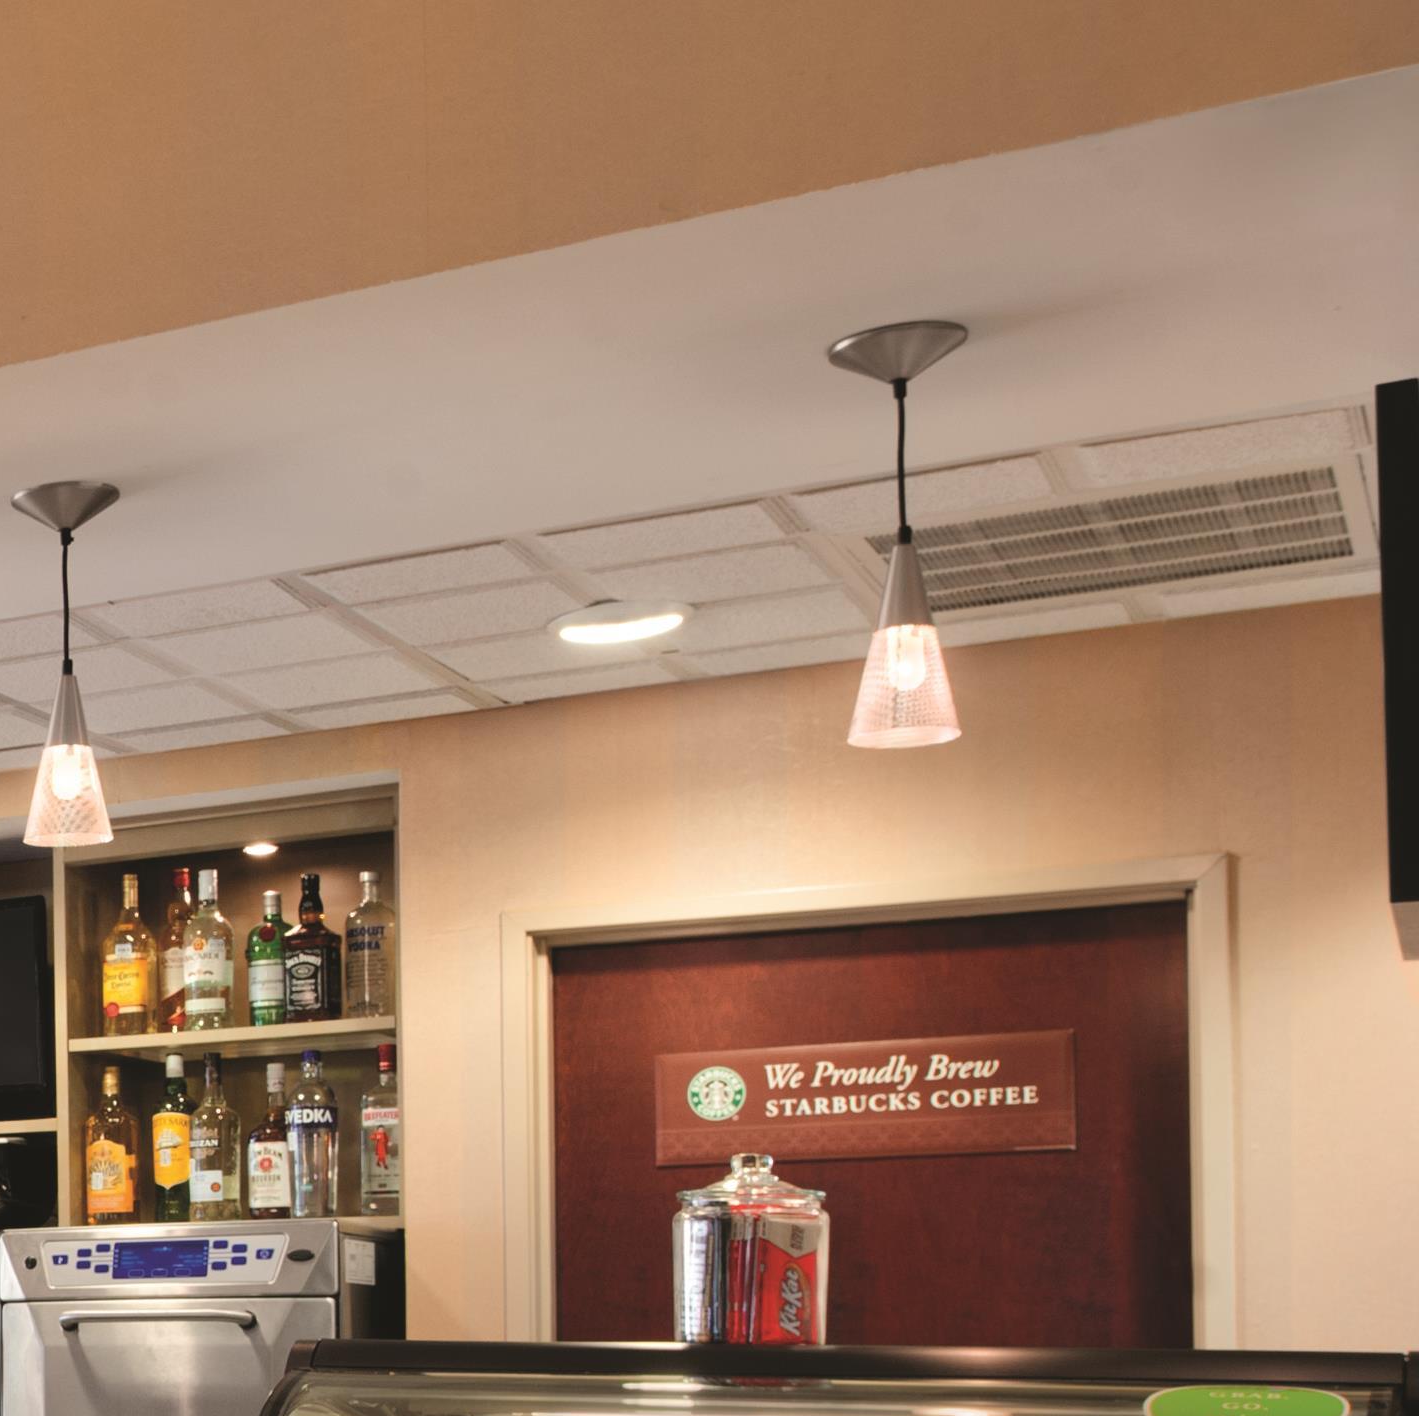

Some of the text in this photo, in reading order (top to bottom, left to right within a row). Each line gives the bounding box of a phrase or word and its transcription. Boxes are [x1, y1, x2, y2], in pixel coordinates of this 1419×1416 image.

[764, 1053, 1000, 1091] We Proudly Brew
[765, 1085, 1039, 1118] STARBUCKS COFFEE
[1209, 1391, 1289, 1400] GRAB.
[1221, 1401, 1269, 1411] GO.
